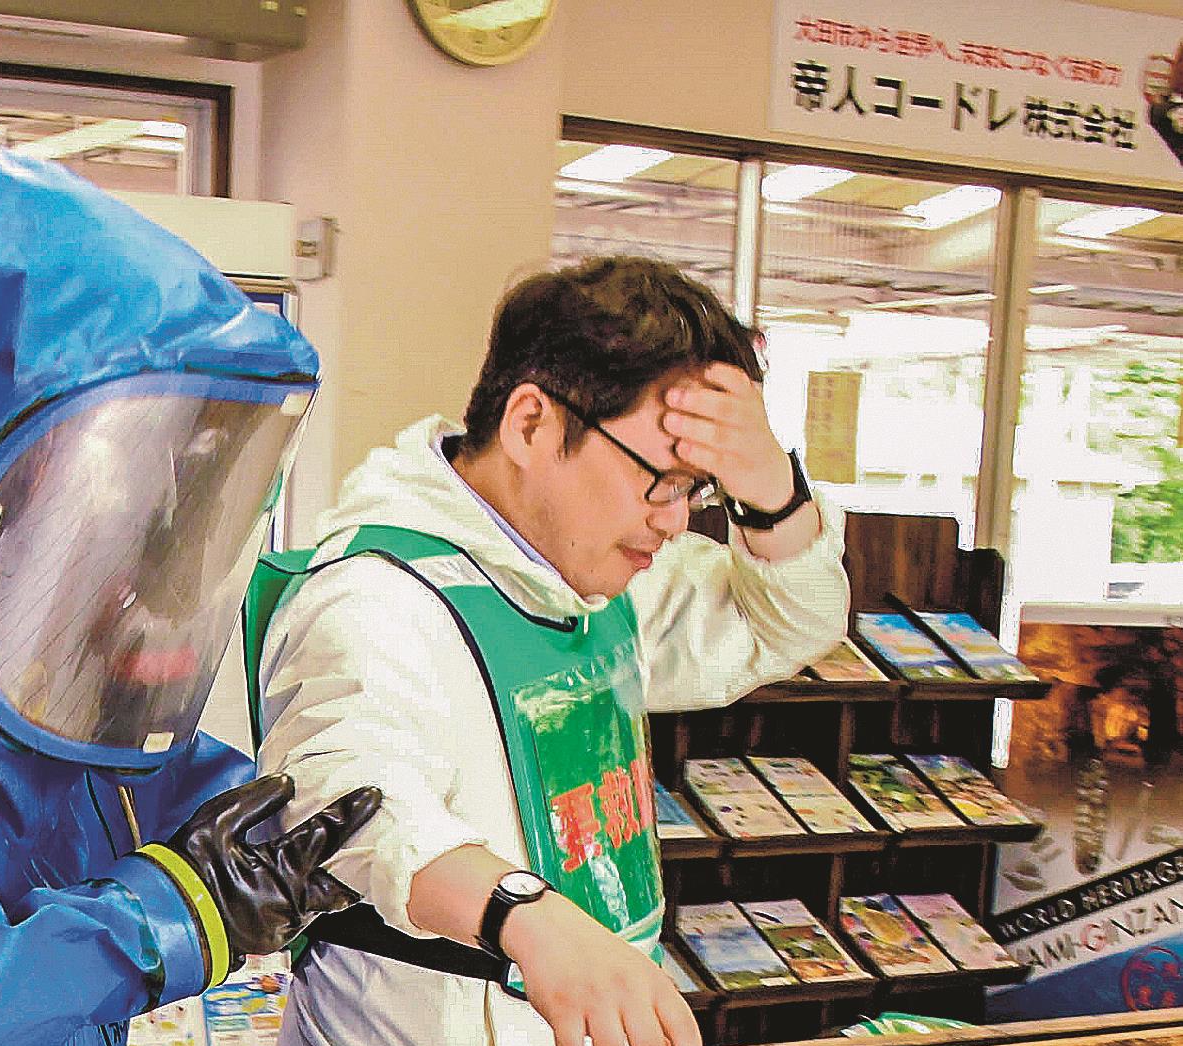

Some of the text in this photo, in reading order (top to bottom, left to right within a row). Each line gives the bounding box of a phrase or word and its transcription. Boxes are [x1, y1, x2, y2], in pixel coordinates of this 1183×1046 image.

[792, 59, 1138, 150] 帝人コードレ株式会社
